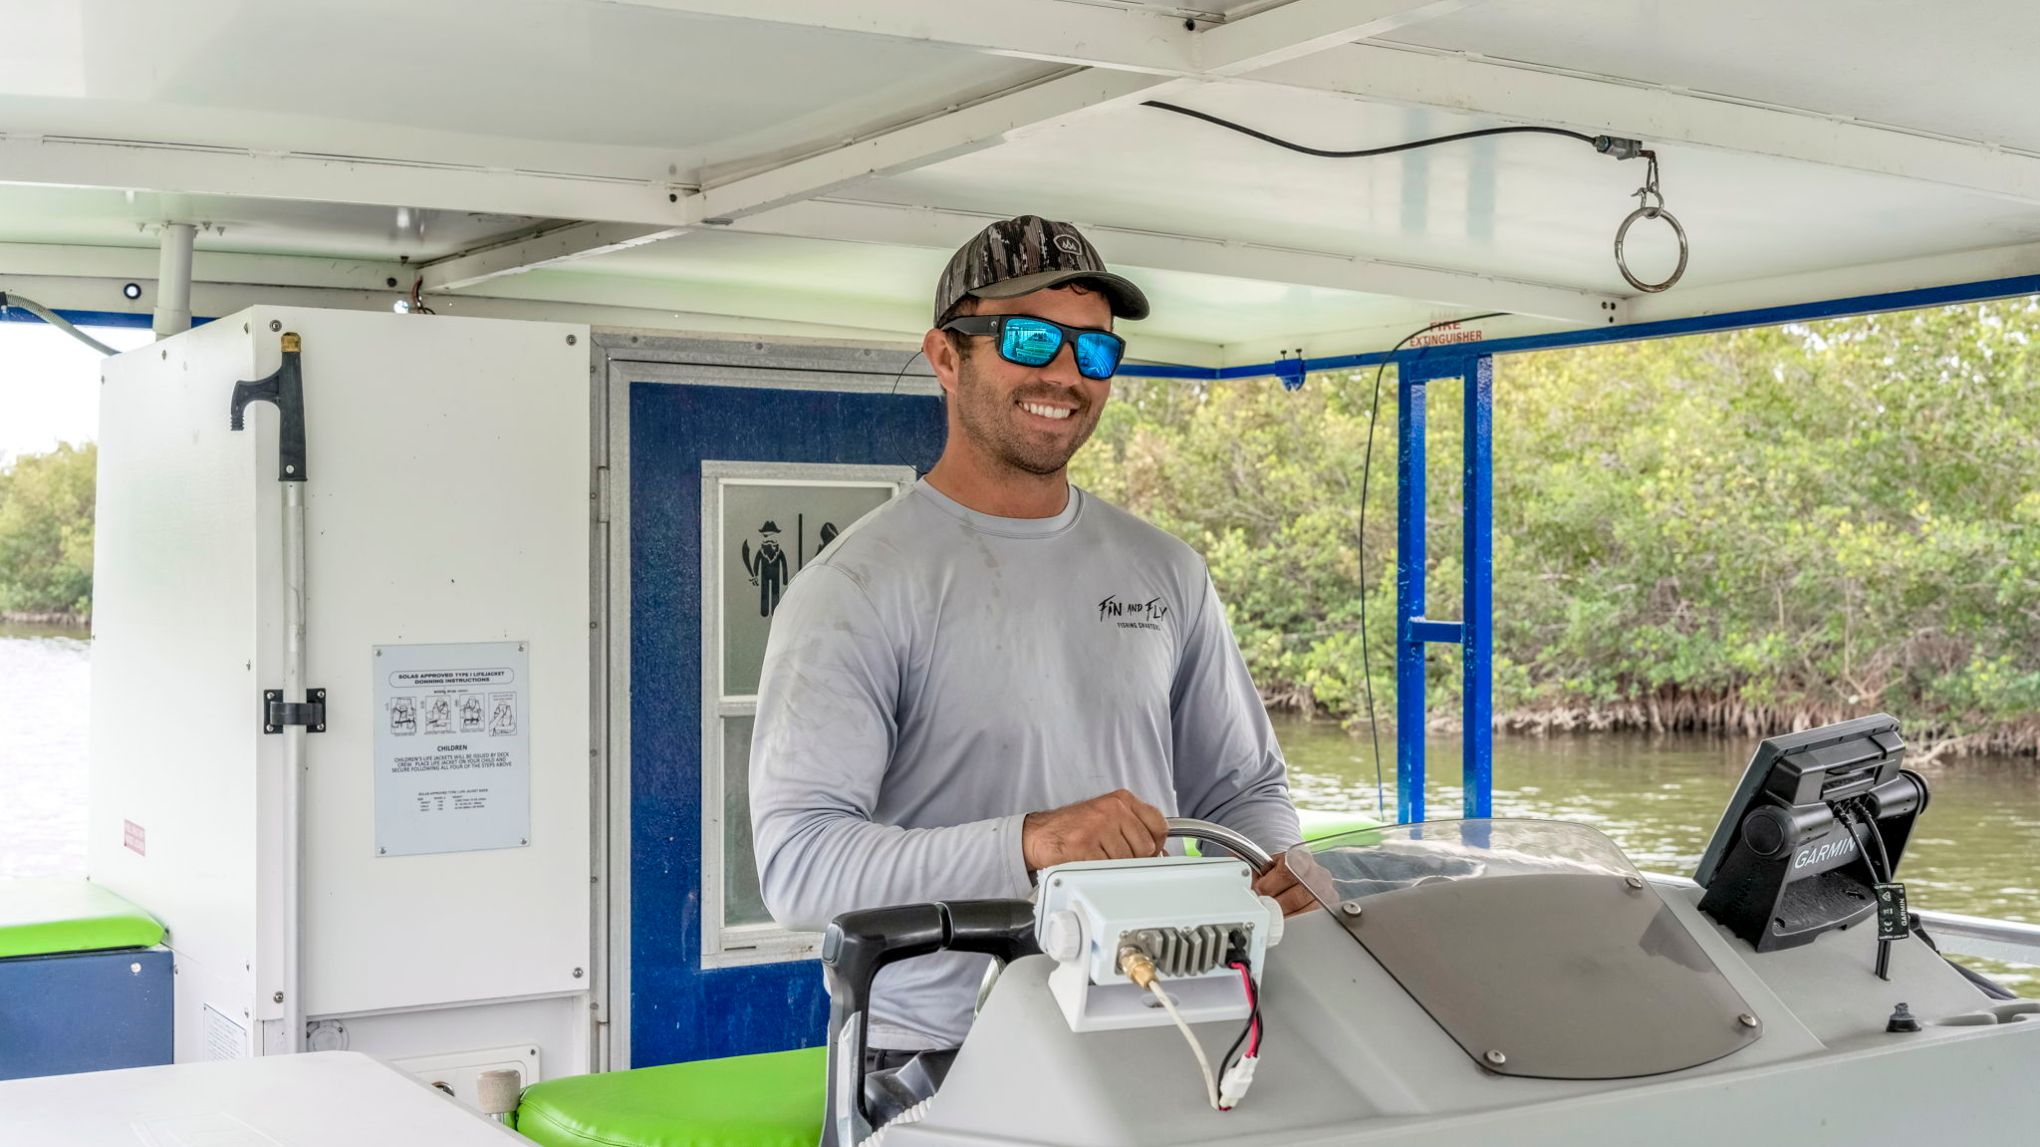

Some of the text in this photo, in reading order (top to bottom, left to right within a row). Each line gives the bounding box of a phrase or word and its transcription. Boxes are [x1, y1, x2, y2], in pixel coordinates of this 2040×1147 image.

[1410, 330, 1482, 347] EXTINGUISHER
[1127, 603, 1143, 616] AND
[1145, 597, 1167, 622] FLY
[437, 744, 468, 752] CHILDREN
[1794, 836, 1857, 869] GARMIN
[1899, 898, 1908, 927] GARMIN
